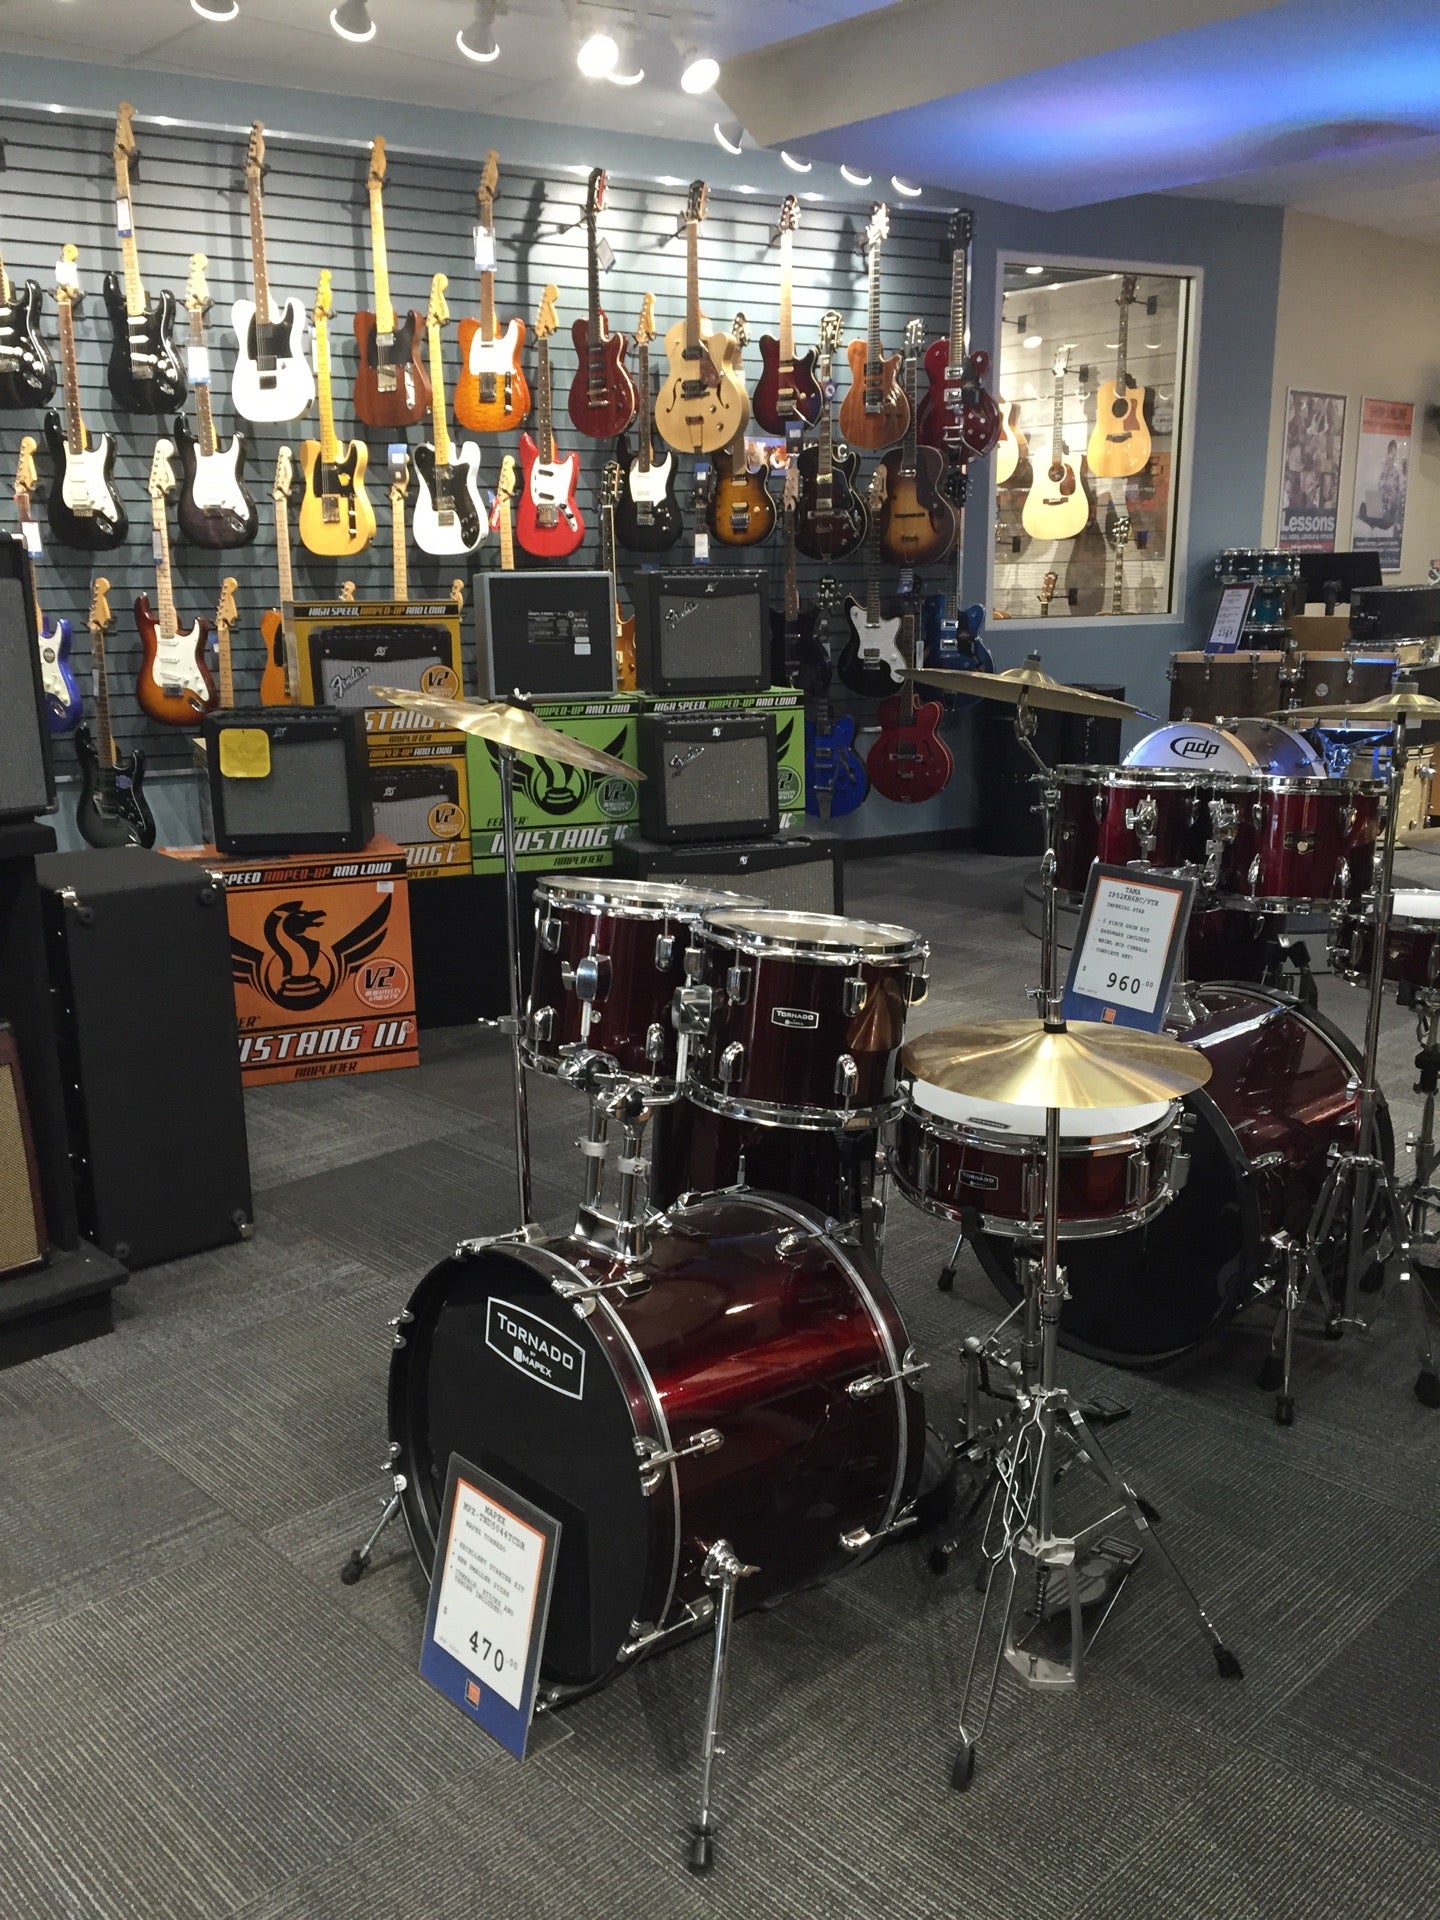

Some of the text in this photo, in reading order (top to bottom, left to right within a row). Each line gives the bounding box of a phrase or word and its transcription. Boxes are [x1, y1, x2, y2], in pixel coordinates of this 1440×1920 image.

[1281, 510, 1335, 532] Lessons
[309, 607, 330, 616] HIGH
[406, 606, 423, 615] AND
[424, 605, 446, 614] LOUD
[330, 666, 370, 698] Fender
[428, 671, 449, 687] V2
[534, 704, 630, 715] AMPED-UP AND LOUD
[654, 702, 676, 712] HIGH
[707, 699, 755, 709] AMPED-UP
[755, 697, 774, 707] AND
[774, 696, 797, 706] LOUD
[365, 711, 435, 730] STANG
[413, 747, 431, 756] AND
[431, 746, 453, 755] LOUD
[1182, 739, 1220, 759] pdp
[604, 781, 629, 801] V2
[435, 808, 455, 824] V2
[487, 816, 525, 827] FEER
[553, 854, 604, 866] AMPLIFIER
[263, 867, 331, 882] AMPED-UP
[333, 864, 359, 877] AND
[360, 862, 392, 875] LOUD
[1125, 886, 1141, 895] TAMA
[365, 966, 396, 989] V2
[776, 1010, 814, 1021] TORNADO
[238, 1025, 363, 1063] USTANG
[294, 1061, 358, 1079] AMPLIFIER
[497, 1312, 574, 1371] TORNADO
[522, 1353, 553, 1379] MAPEX
[484, 1505, 507, 1526] MAPEX
